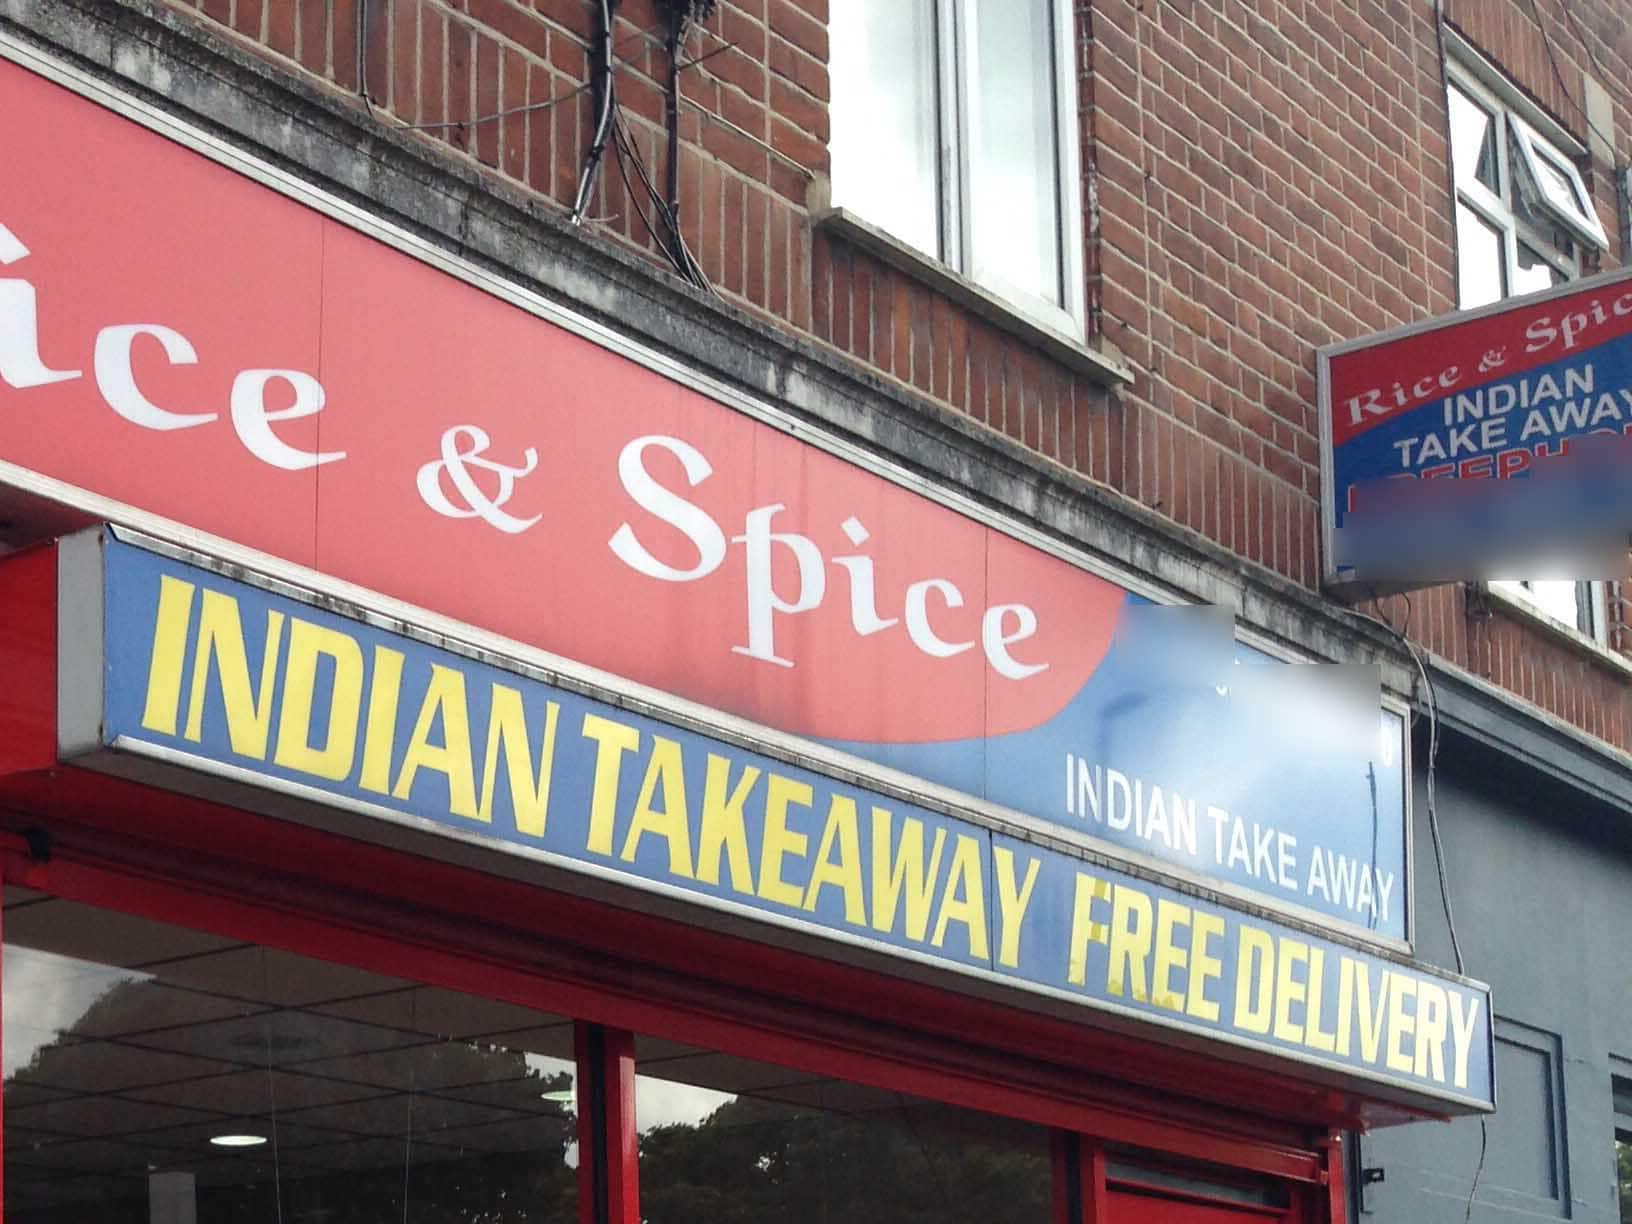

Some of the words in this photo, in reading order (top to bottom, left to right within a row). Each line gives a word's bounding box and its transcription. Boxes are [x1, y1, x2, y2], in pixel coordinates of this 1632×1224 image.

[1344, 366, 1463, 426] Rice
[1478, 345, 1507, 373] &
[1393, 416, 1508, 468] TAKE
[1443, 363, 1595, 427] INDIAN
[416, 424, 543, 535] &
[608, 435, 1049, 680] Spice
[140, 573, 562, 839] INDIAN
[580, 711, 1042, 968] TAKEAWAY
[1067, 872, 1225, 1023] FREE
[1233, 925, 1480, 1089] DELIVERY
[1066, 753, 1198, 856] INDIAN
[1208, 805, 1299, 891] TAKE
[1306, 846, 1395, 921] AWAY
